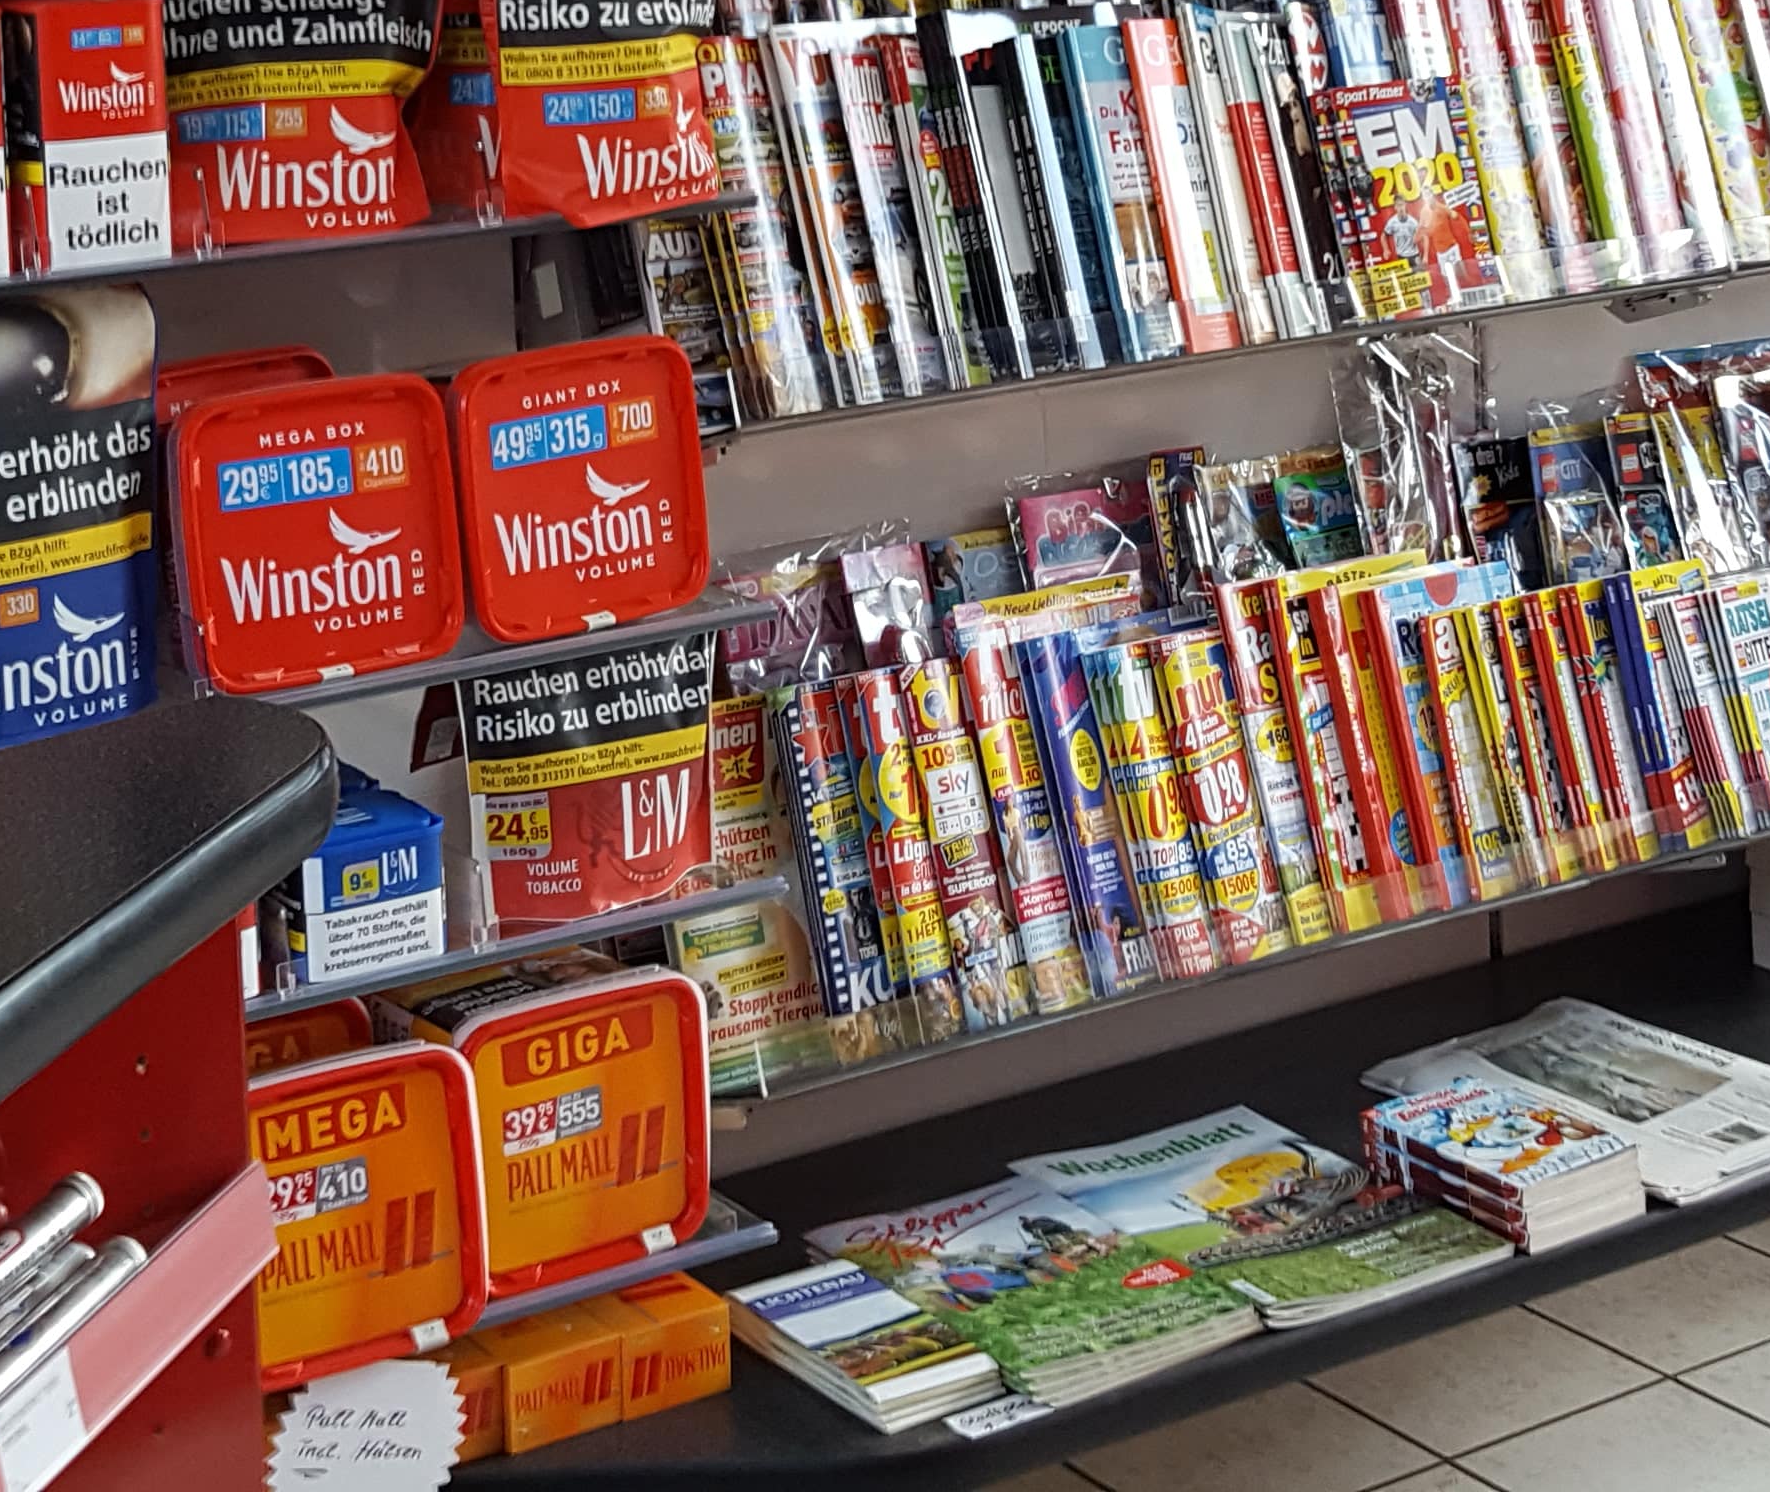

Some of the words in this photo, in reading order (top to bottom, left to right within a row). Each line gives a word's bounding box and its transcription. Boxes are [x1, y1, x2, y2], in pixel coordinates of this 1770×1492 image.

[599, 0, 629, 25] zu
[229, 18, 284, 48] und
[293, 12, 430, 53] Zahnfleisch
[1336, 89, 1369, 107] Sport
[1372, 84, 1404, 102] Planer
[1355, 99, 1456, 170] EM
[50, 158, 166, 188] Rauchen
[1372, 153, 1463, 208] 2020
[97, 193, 129, 215] ist
[66, 221, 159, 249] tödlich
[521, 386, 577, 410] GIANT
[618, 402, 653, 432] 700
[106, 421, 152, 454] das
[259, 427, 316, 449] MEGA
[326, 422, 366, 440] BOX
[366, 445, 404, 475] 410
[7, 468, 141, 523] erblinden
[661, 498, 673, 543] RED
[8, 544, 42, 564] BZgA
[493, 503, 654, 577] Winston
[411, 548, 425, 596] RED
[575, 553, 656, 582] VOLUME
[6, 593, 35, 615] 330
[220, 550, 403, 626] Winston
[312, 606, 405, 634] VOLUME
[474, 669, 578, 707] Rauchen
[585, 651, 667, 687] erhöht
[34, 694, 129, 726] VOLUME
[477, 709, 556, 743] Risiko
[562, 708, 589, 731] zu
[939, 772, 970, 795] sky
[620, 767, 691, 861] L&M
[381, 844, 417, 886] L&M
[527, 858, 579, 876] VOLUME
[526, 879, 582, 895] TOBACCO
[324, 909, 389, 930] Tabakrauch
[730, 989, 775, 1016] Stoppt
[527, 1016, 631, 1078] GIGA
[264, 1093, 402, 1160] MEGA
[1048, 1122, 1256, 1179] Wochenblatt
[506, 1154, 560, 1204] PALL
[560, 1137, 614, 1189] MALL
[319, 1221, 379, 1273] MALL
